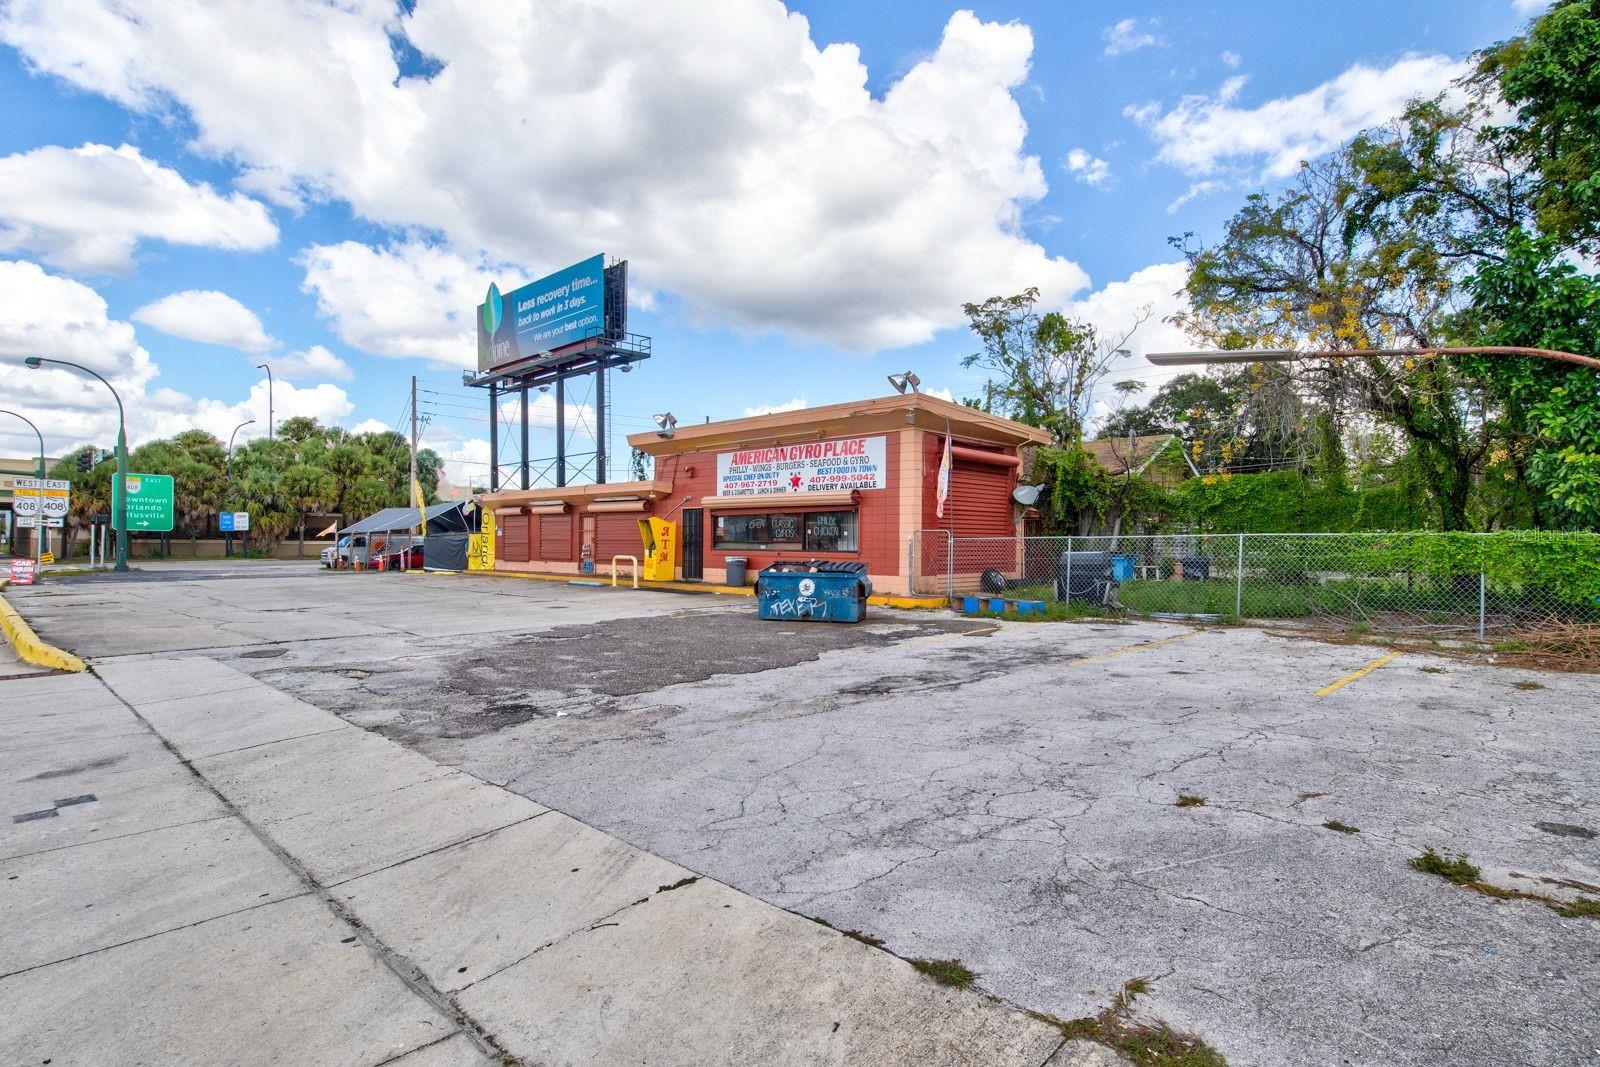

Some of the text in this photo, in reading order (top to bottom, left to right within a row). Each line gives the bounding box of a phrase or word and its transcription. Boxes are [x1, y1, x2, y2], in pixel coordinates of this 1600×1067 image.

[518, 298, 536, 313] Less
[536, 284, 570, 306] recovery
[518, 295, 586, 327] back to work in 3 days.
[533, 314, 598, 342] We are your best option.
[731, 439, 866, 466] AMERICAN GYRO PLACE
[729, 466, 748, 474] PHILLY
[752, 463, 771, 473] WINGS
[776, 460, 805, 471] BURGERS
[809, 457, 841, 467] SEAFOOD
[842, 457, 848, 465] &
[849, 455, 870, 465] GYRO
[832, 466, 850, 474] FOOD
[859, 464, 878, 472] TOWN
[16, 479, 38, 487] WEST
[809, 473, 876, 483] 407-999-5042
[46, 480, 66, 488] EAST
[724, 479, 778, 489] 407-967-2719
[840, 481, 877, 490] AVAILABLE
[16, 502, 36, 511] 408
[44, 502, 64, 511] 408
[659, 526, 670, 564] ATM
